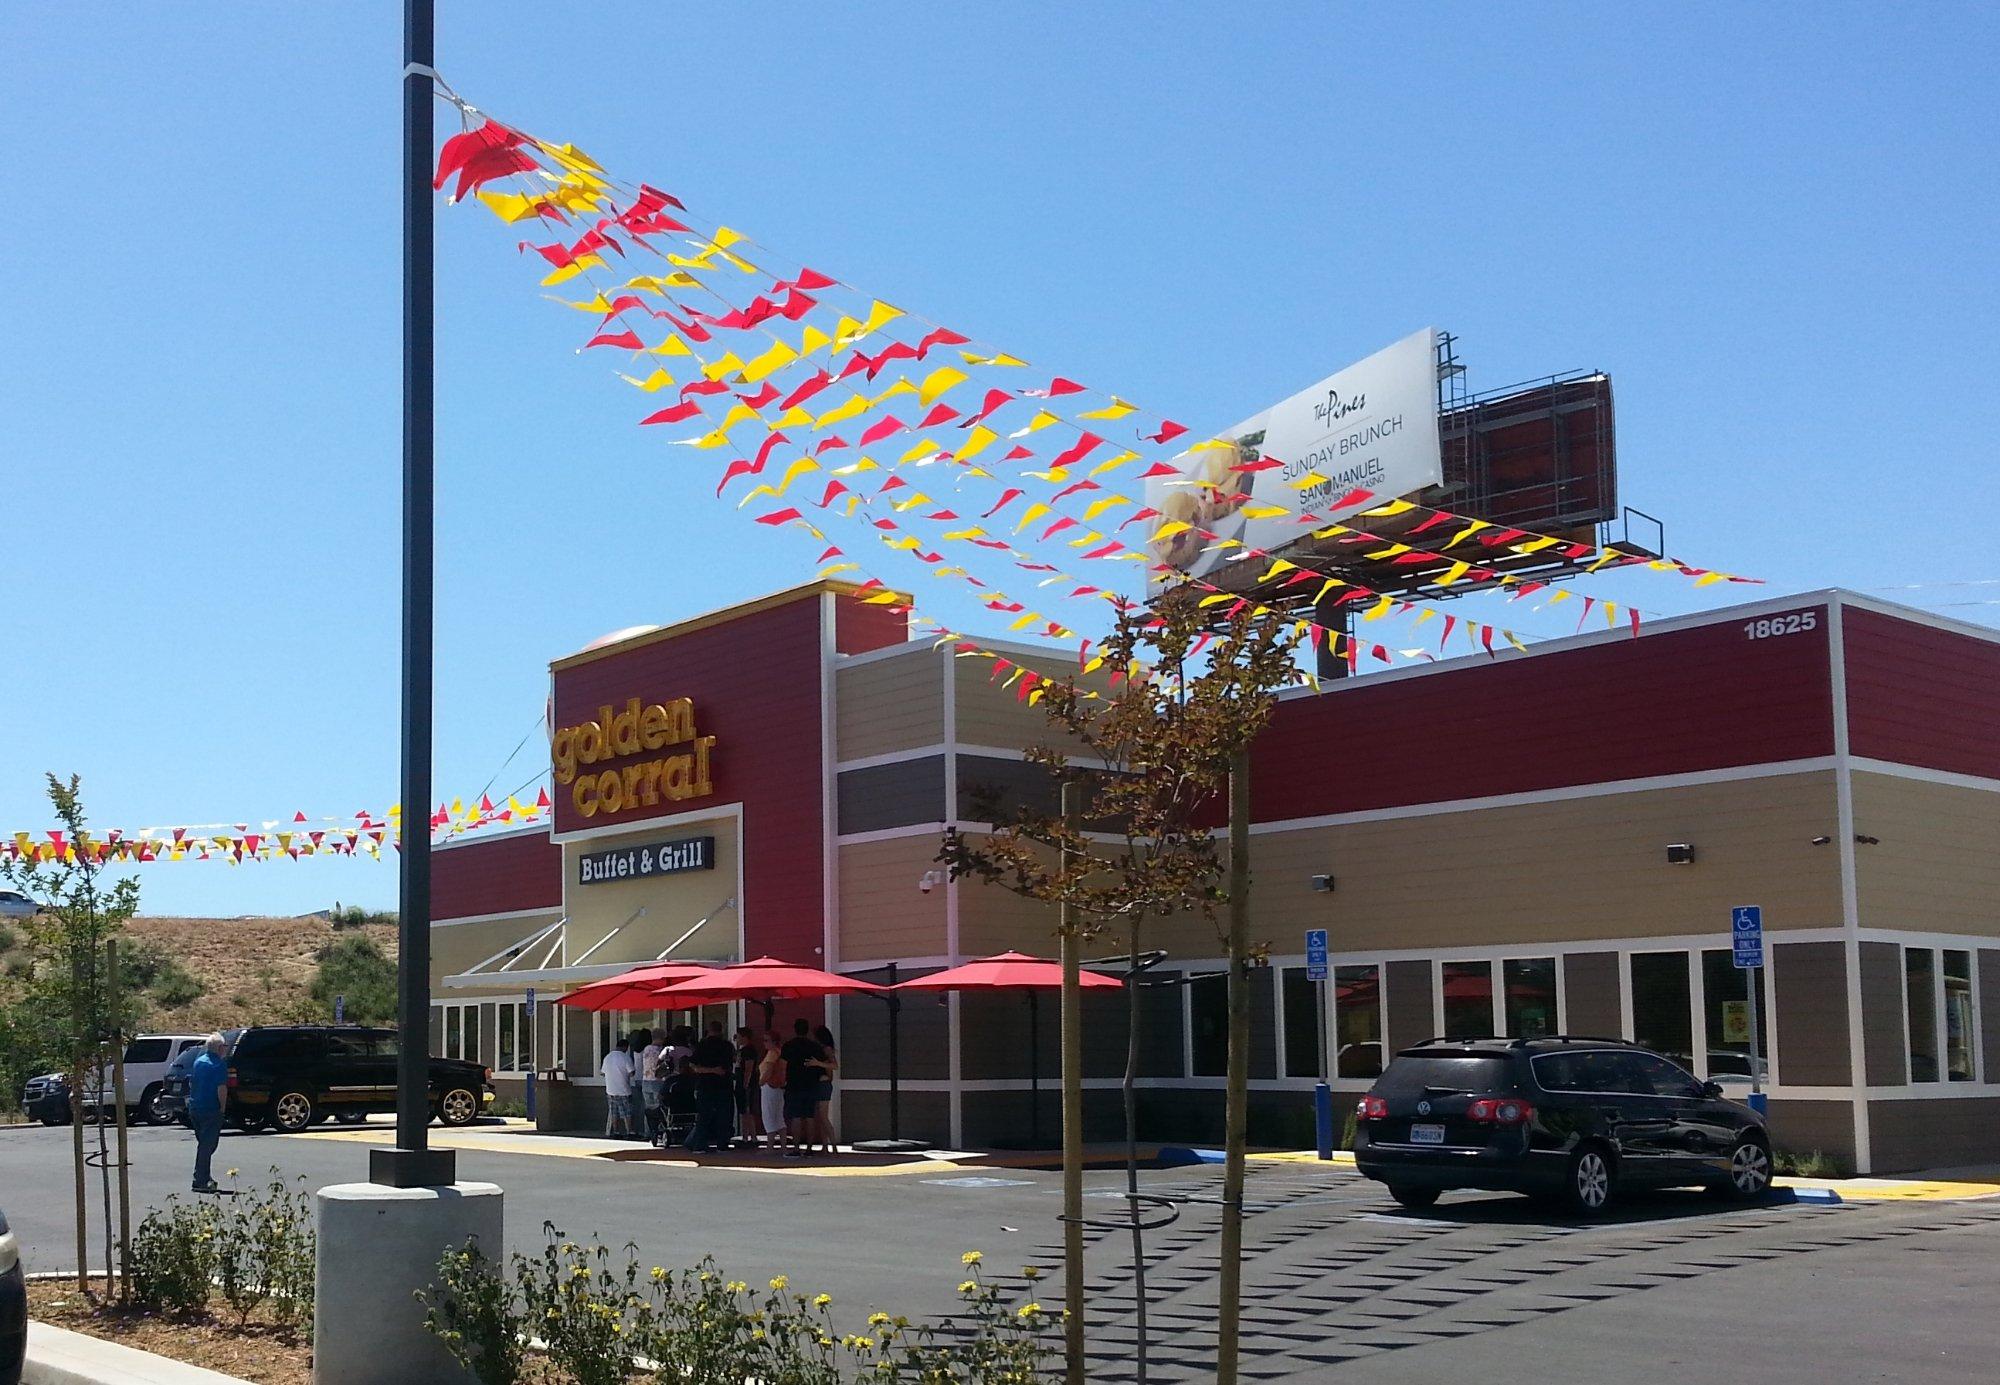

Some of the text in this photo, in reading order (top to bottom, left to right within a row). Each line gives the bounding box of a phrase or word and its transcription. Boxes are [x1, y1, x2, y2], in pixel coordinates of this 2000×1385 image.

[1327, 390, 1366, 428] Pines
[1282, 414, 1402, 481] SUNDAY BRUNCH
[1300, 457, 1384, 505] SAN MANUEL
[1744, 612, 1816, 640] 18625
[552, 697, 697, 785] golden
[572, 735, 716, 818] corral
[581, 841, 703, 881] Buffet & Grill
